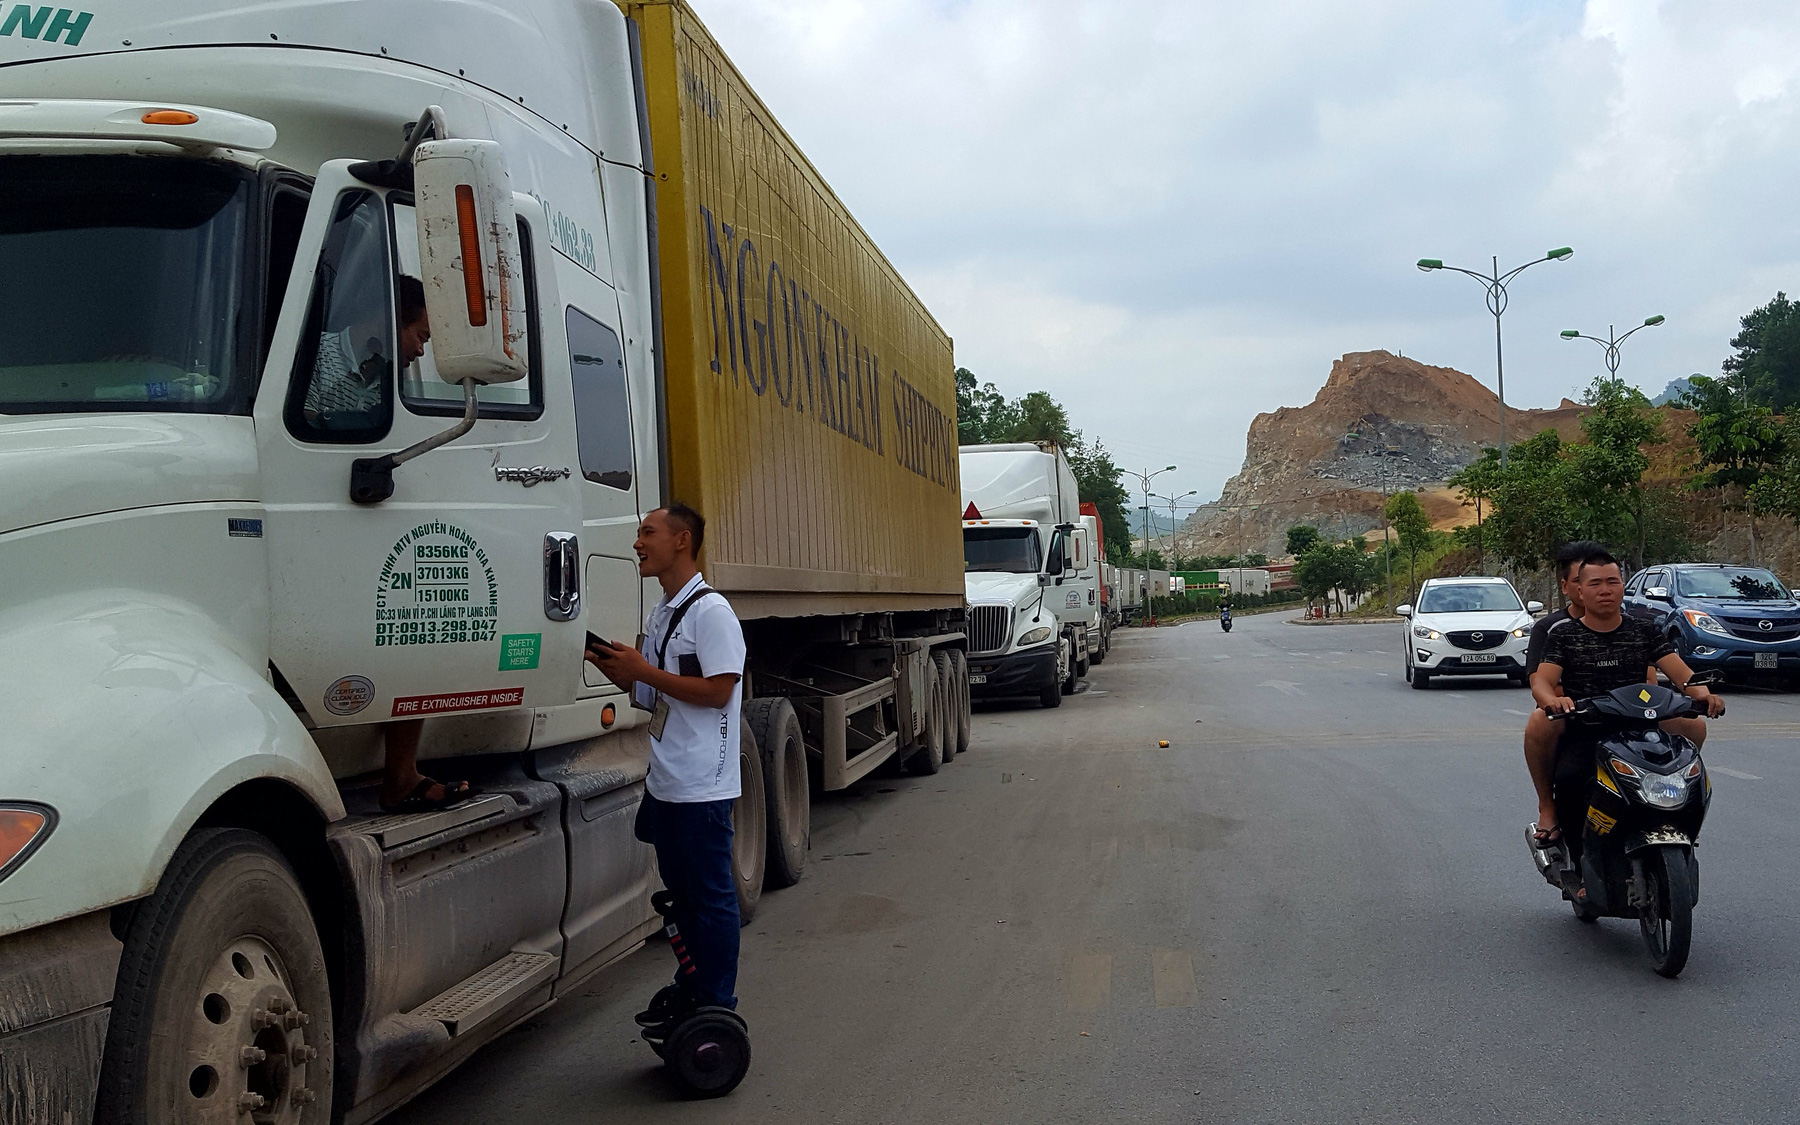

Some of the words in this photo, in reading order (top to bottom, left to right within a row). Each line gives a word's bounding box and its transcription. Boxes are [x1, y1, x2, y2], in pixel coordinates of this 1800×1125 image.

[0, 4, 94, 47] NH
[700, 204, 885, 458] NGONKHAM
[892, 368, 957, 495] SHIPPING
[416, 545, 469, 559] 8356KG
[393, 533, 412, 556] MTV
[475, 548, 489, 568] GIA
[484, 567, 499, 607] KHÁNH
[417, 566, 469, 580] 37013KG
[390, 572, 412, 590] 2N
[417, 588, 469, 602] 15100KG
[397, 606, 412, 620] VĂN
[439, 605, 457, 619] LĂNG
[457, 606, 466, 618] TP
[467, 606, 483, 620] LẠNG
[508, 638, 536, 648] SAFETY
[507, 647, 535, 657] STARTS
[510, 656, 530, 666] HERE
[396, 701, 419, 713] FIRE
[421, 695, 488, 711] EXTINGUISHER
[490, 692, 519, 704] INSIDE
[720, 712, 728, 740] XTEP
[714, 739, 727, 786] FOOTBALL
